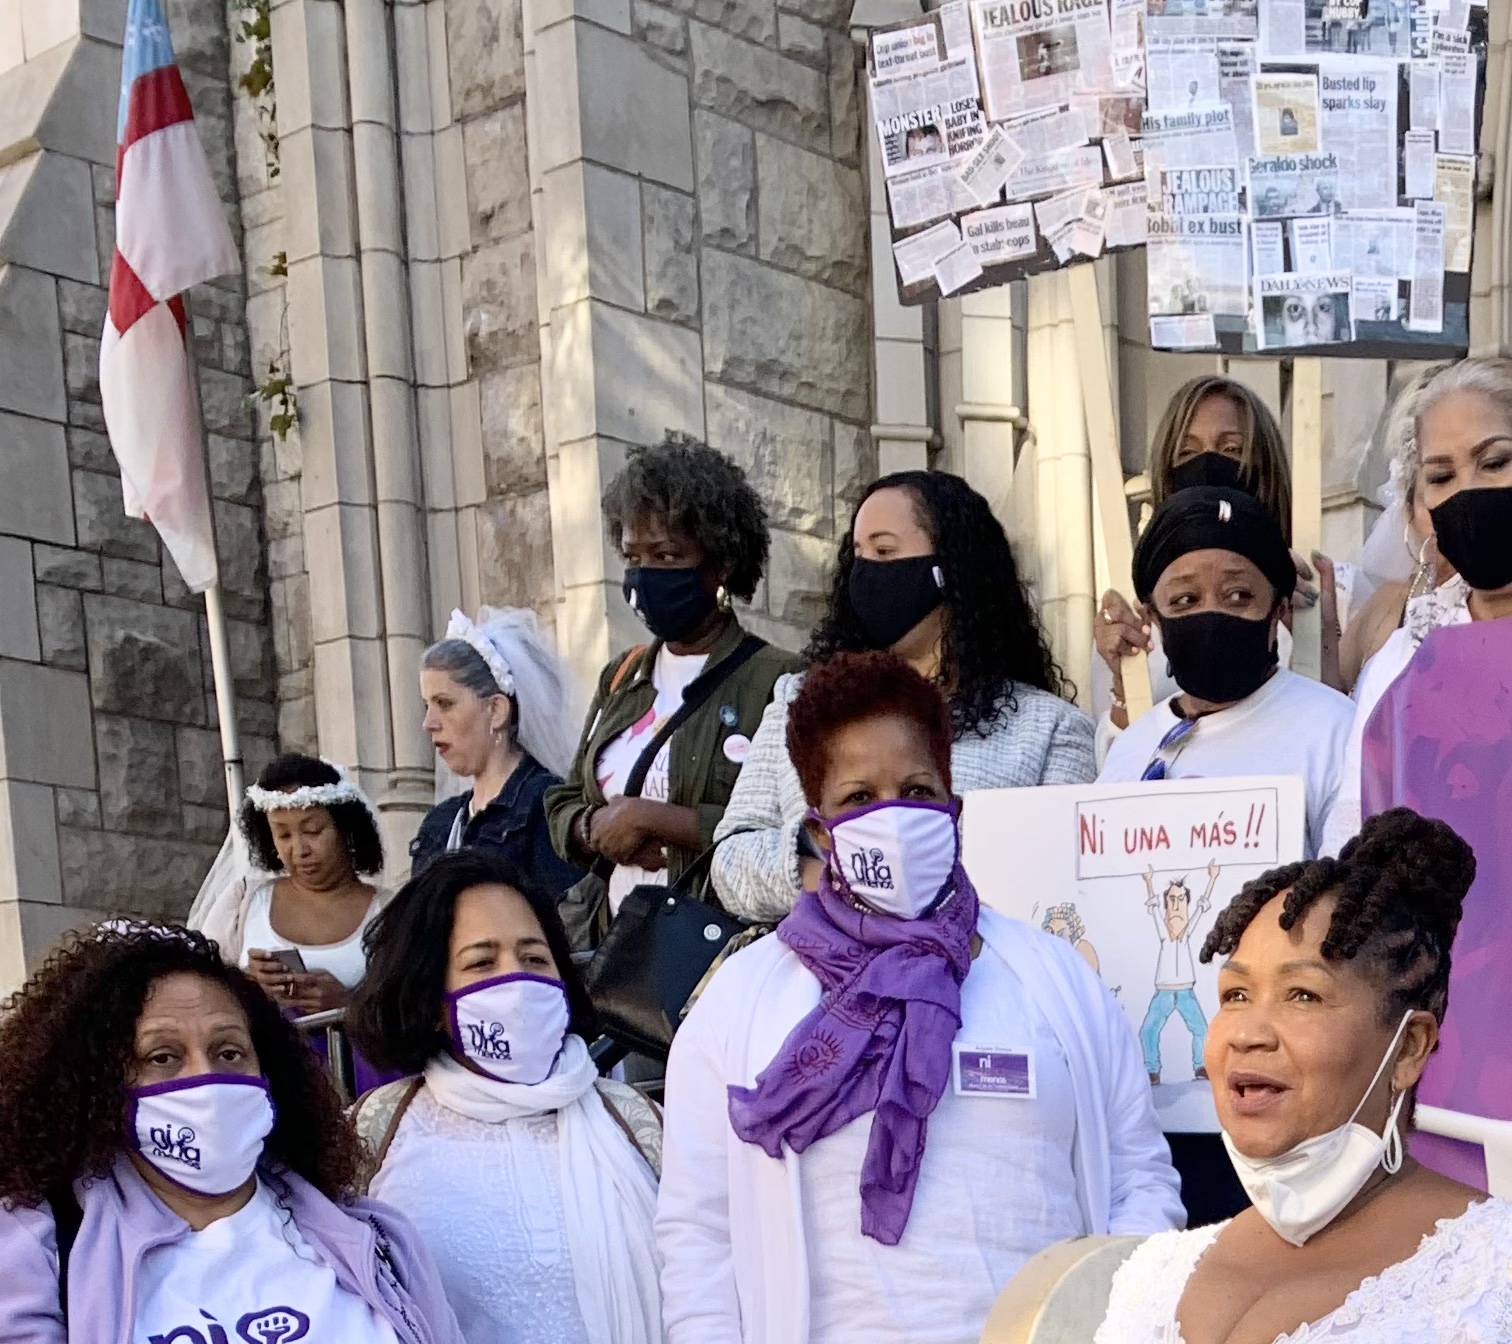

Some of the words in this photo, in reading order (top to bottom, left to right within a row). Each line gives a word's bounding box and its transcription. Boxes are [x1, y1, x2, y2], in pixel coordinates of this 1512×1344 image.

[983, 0, 1053, 31] JEALOUS
[1322, 76, 1360, 91] Busted
[1362, 77, 1376, 93] lip
[1322, 96, 1361, 111] sparks
[1364, 96, 1386, 112] slay
[876, 104, 943, 137] MONSTER
[945, 112, 971, 129] BABY
[1142, 117, 1161, 130] His
[1164, 111, 1202, 128] family
[1205, 109, 1230, 127] plot
[948, 124, 983, 143] KNIFING
[1249, 155, 1296, 174] Geraldo
[1299, 153, 1338, 171] shock
[1162, 169, 1235, 194] JEALOUS
[1162, 192, 1238, 215] RAMPAGE
[967, 224, 984, 238] Gal
[985, 221, 1005, 234] kills
[1005, 217, 1030, 231] beau
[1187, 220, 1206, 234] ex
[1209, 217, 1242, 235] bust
[1006, 234, 1031, 249] cops
[1260, 279, 1301, 292] DAILY
[1305, 277, 1350, 290] NEWS
[1124, 825, 1171, 854] UNA
[979, 1054, 992, 1069] ni
